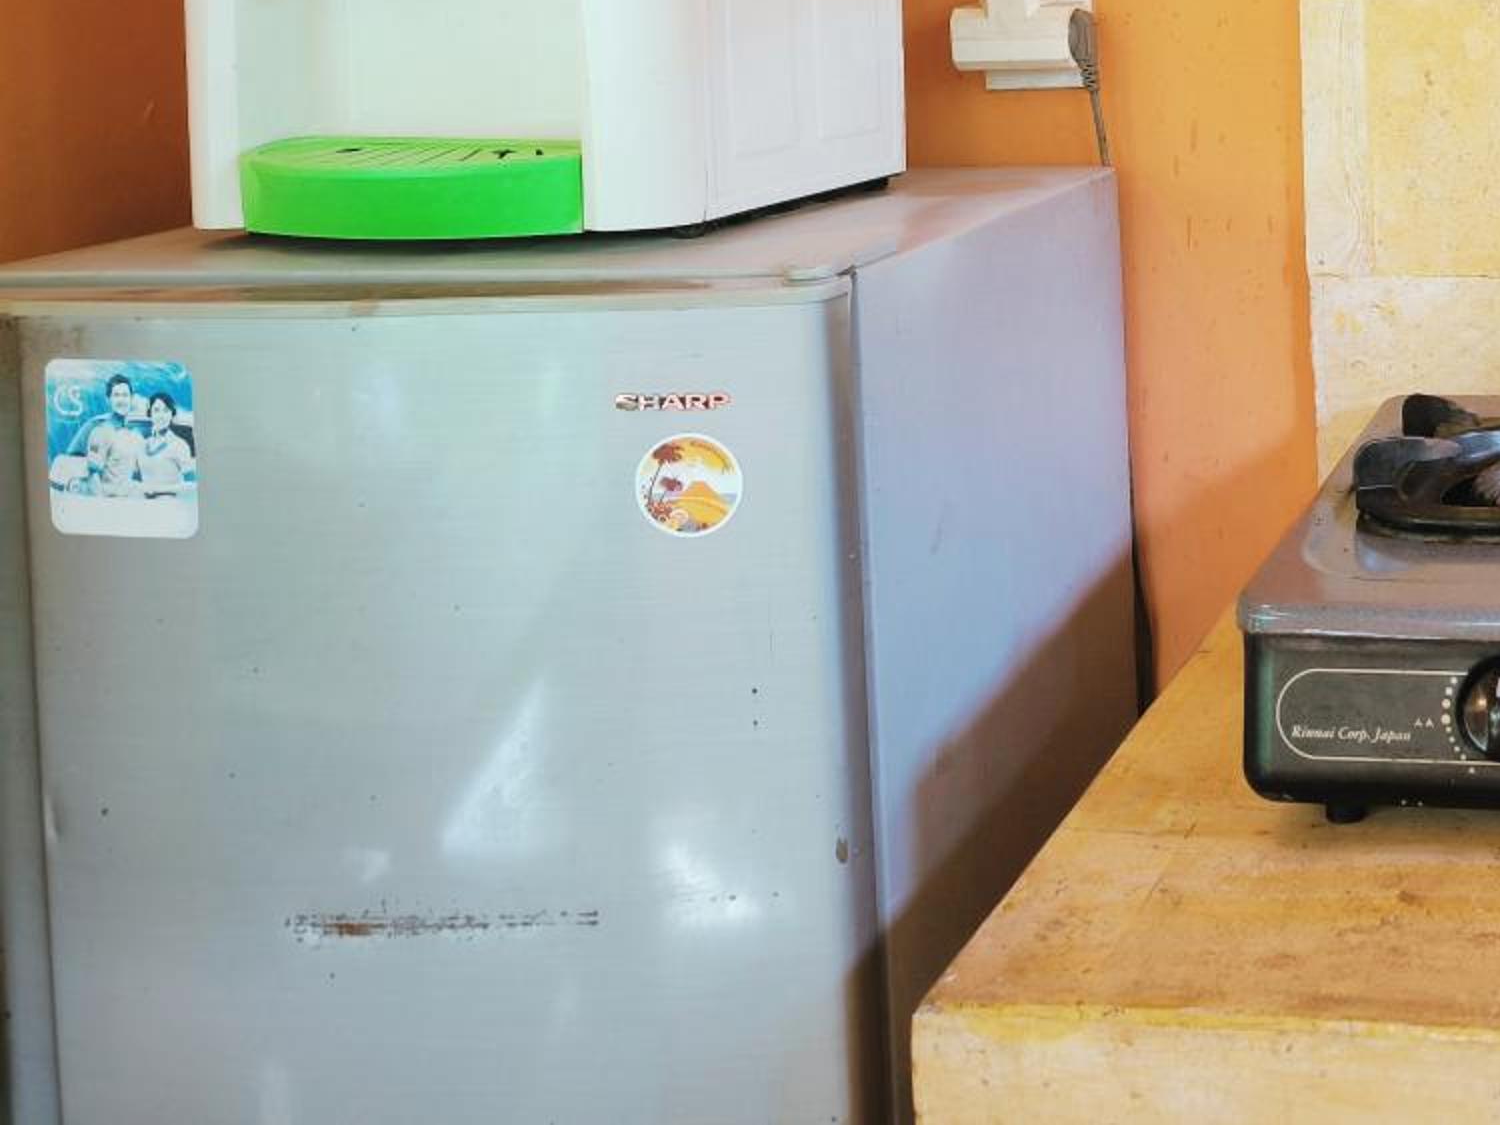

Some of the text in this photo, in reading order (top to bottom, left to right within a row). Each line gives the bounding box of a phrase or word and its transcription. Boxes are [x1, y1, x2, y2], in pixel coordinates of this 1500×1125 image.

[614, 392, 730, 412] SHARP
[1291, 725, 1335, 739] Rinnai
[1371, 726, 1411, 744] Japan
